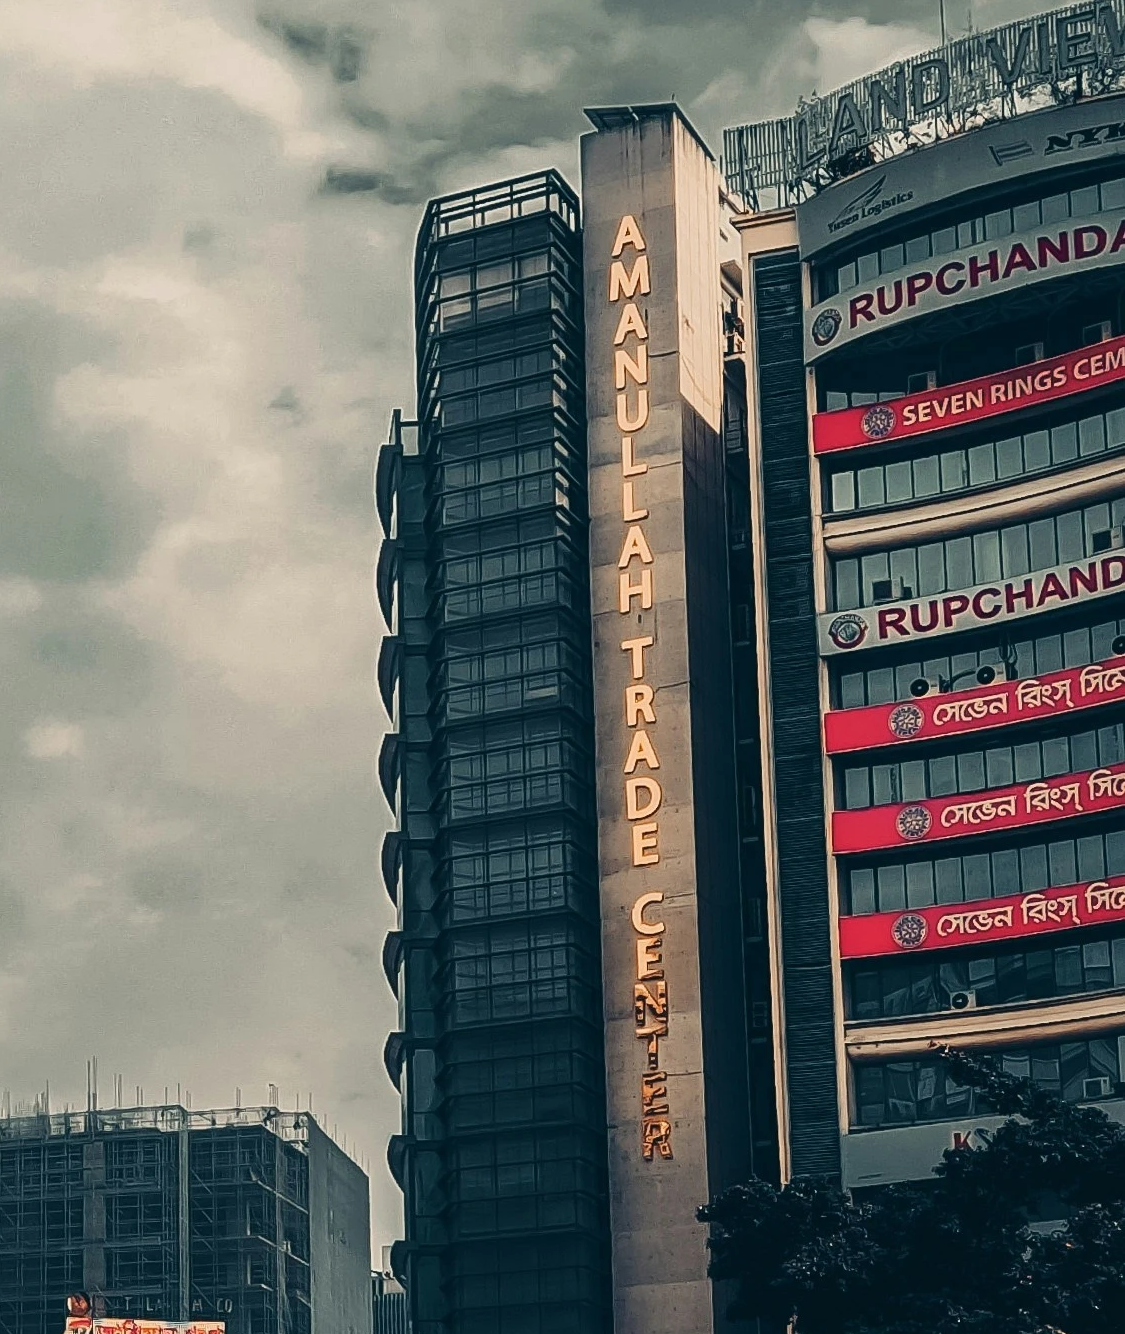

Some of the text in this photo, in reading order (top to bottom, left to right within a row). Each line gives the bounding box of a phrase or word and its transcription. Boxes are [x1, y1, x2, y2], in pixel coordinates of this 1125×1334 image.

[796, 58, 950, 167] LAND
[862, 191, 913, 215] Logistics
[902, 388, 983, 426] SEVEN
[991, 365, 1067, 405] RINGS
[608, 214, 674, 1161] AMANULLAH TRADE CENTER
[932, 692, 1008, 726] সেভেন
[940, 795, 1017, 828] সেভেন
[936, 905, 1014, 938] সেভেন
